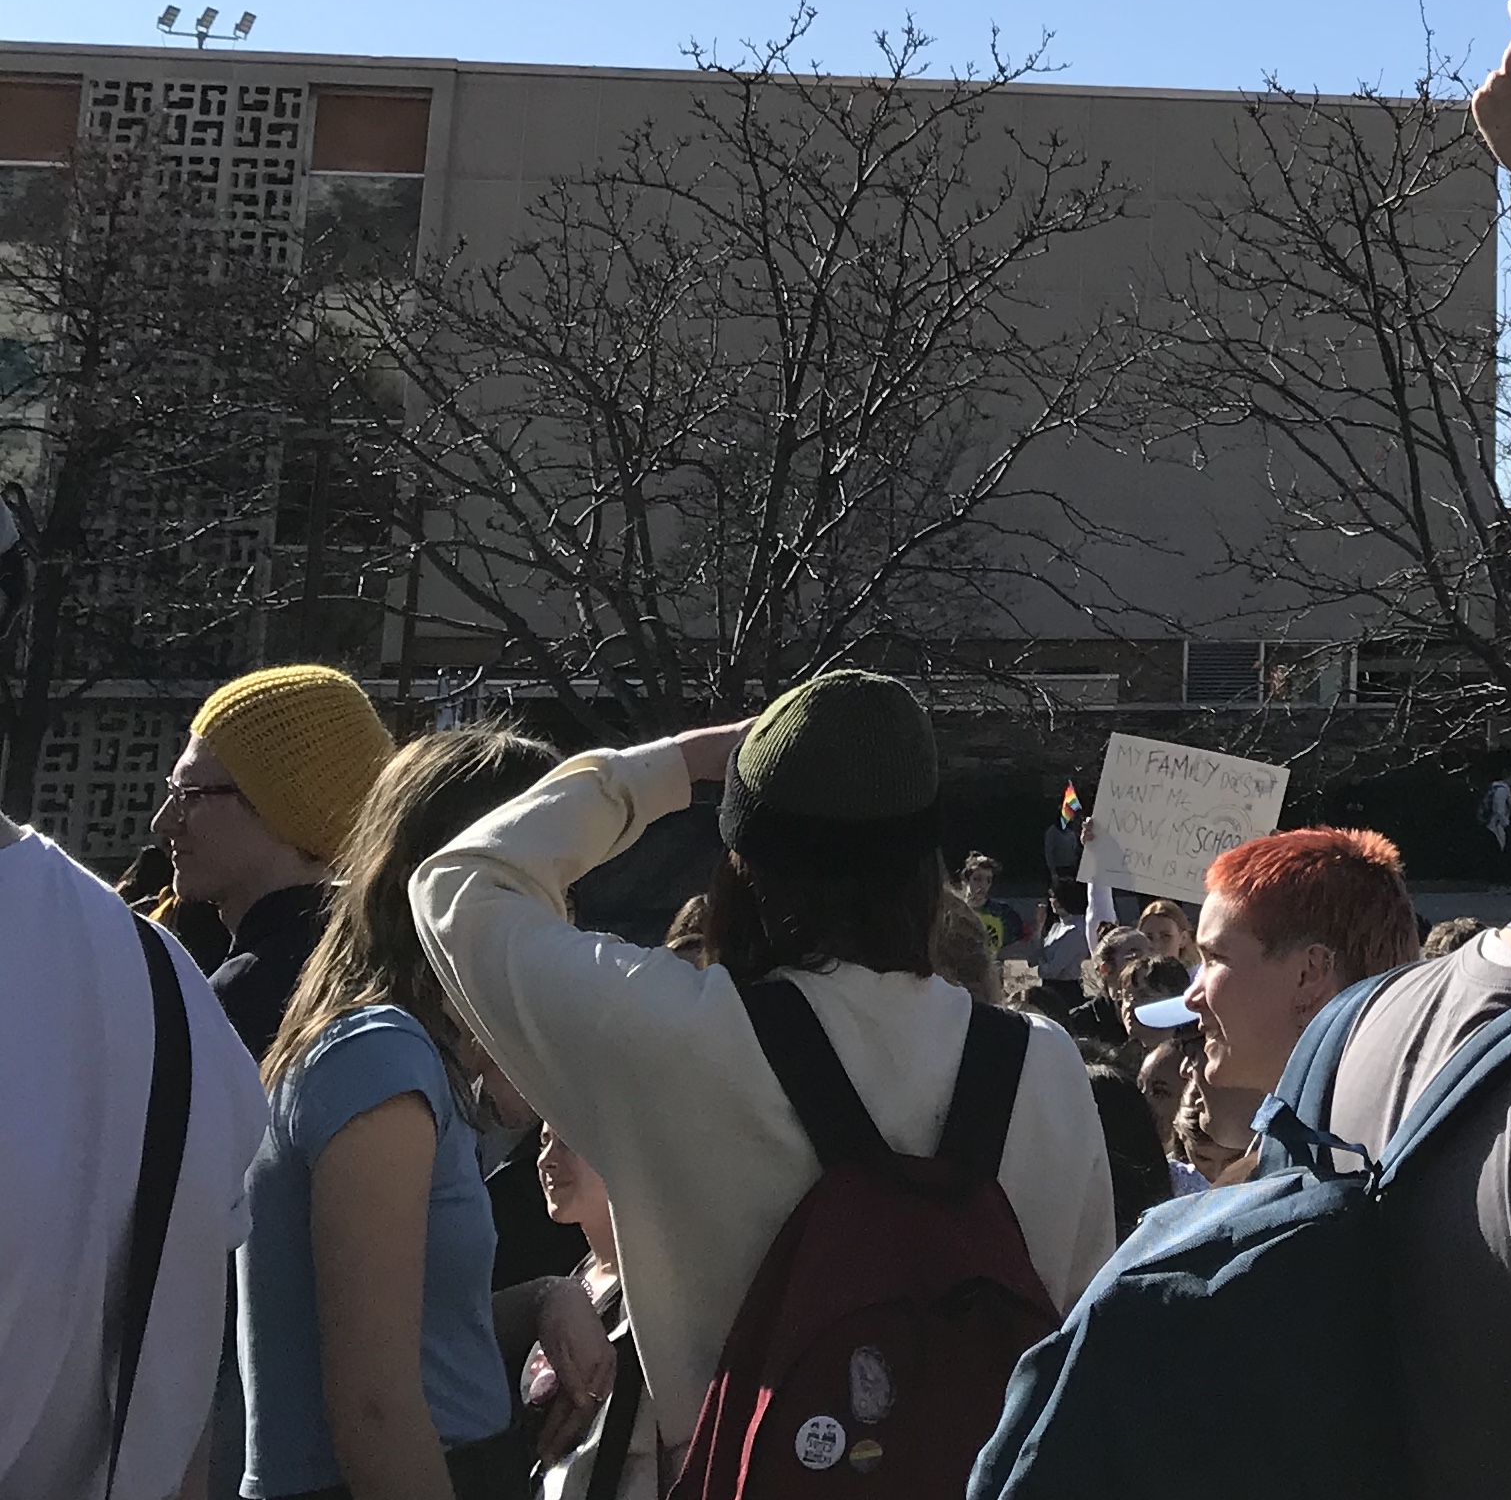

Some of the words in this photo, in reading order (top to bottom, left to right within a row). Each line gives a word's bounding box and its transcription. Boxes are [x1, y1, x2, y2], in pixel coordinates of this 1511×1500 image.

[1116, 743, 1144, 767] MY
[1144, 749, 1221, 789] FAMILY
[1109, 780, 1164, 804] WANT
[1166, 787, 1193, 812] ME
[1191, 826, 1246, 856] SCHOO
